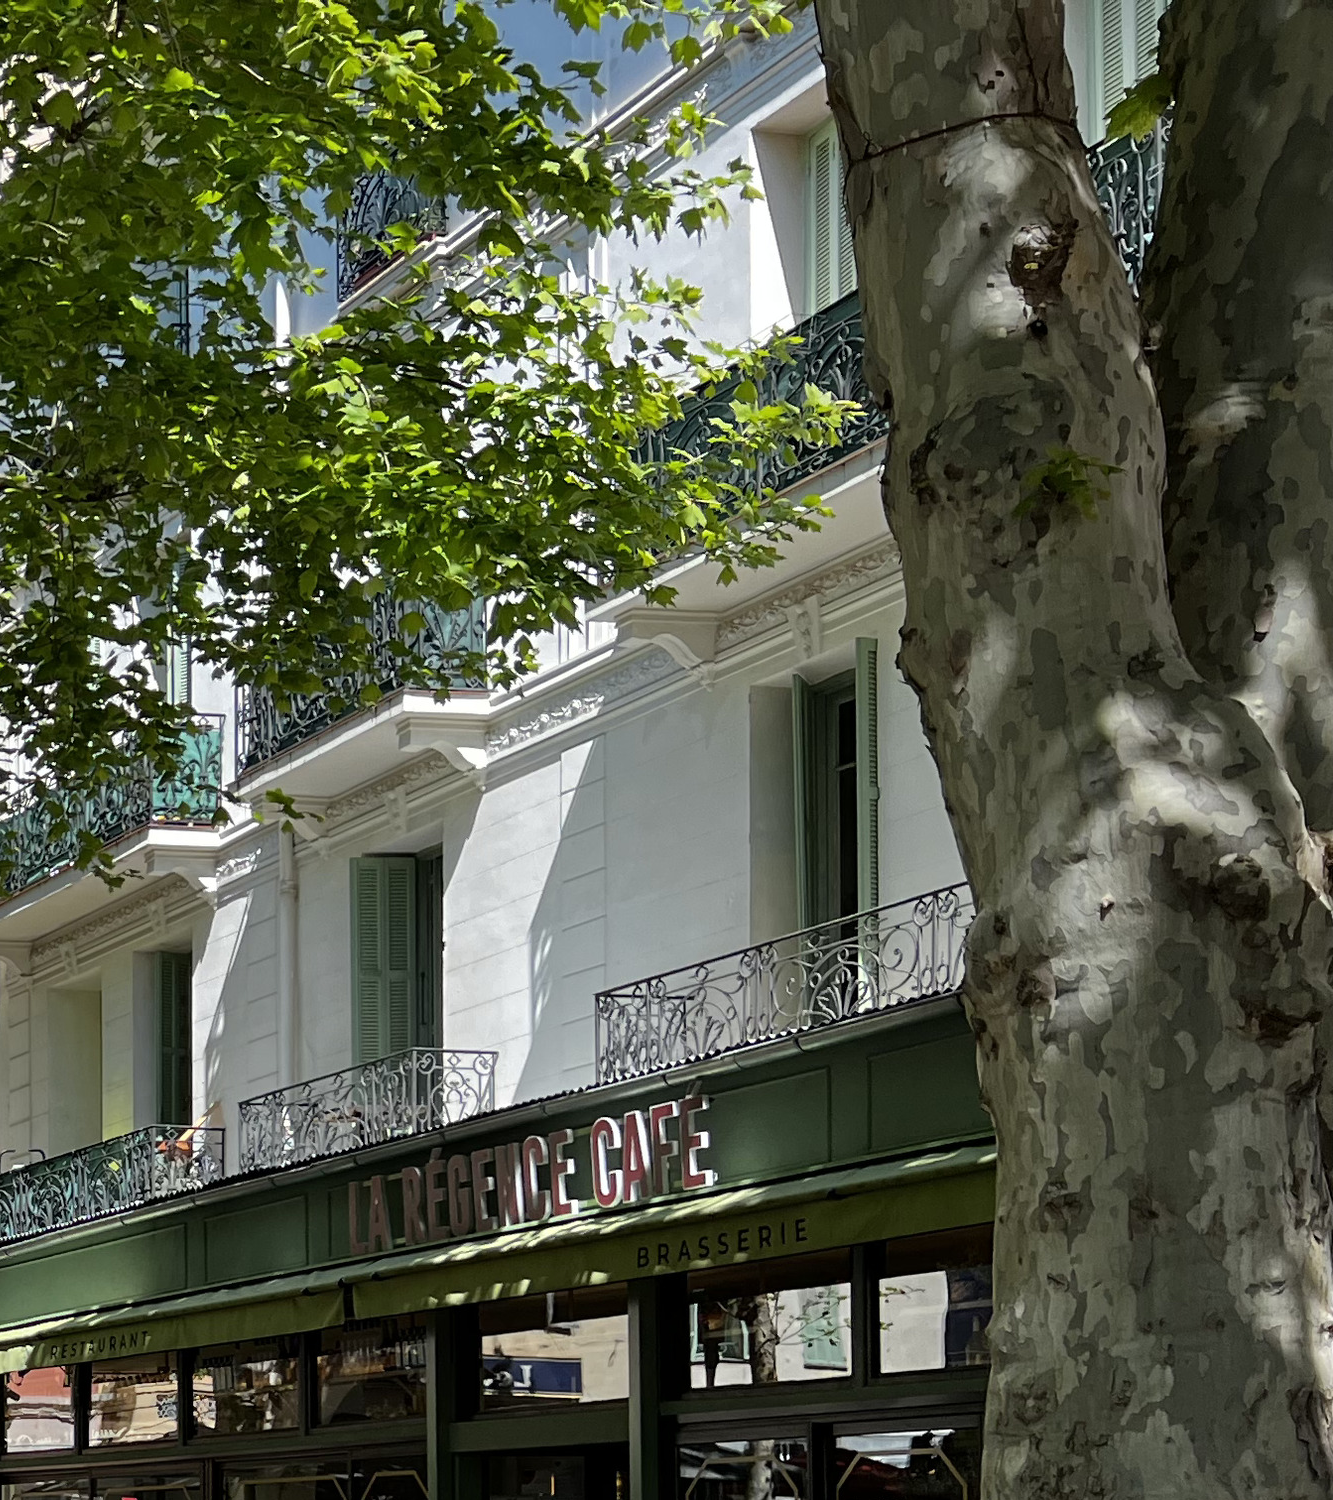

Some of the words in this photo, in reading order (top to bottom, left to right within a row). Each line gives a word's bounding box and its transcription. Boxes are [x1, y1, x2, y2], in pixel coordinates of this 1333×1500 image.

[348, 1174, 393, 1256] LA
[401, 1128, 580, 1246] RÉGENCE
[590, 1081, 719, 1209] CAFÉ
[636, 1217, 808, 1269] BRASSERIE
[49, 1330, 149, 1360] RESTAURANT
